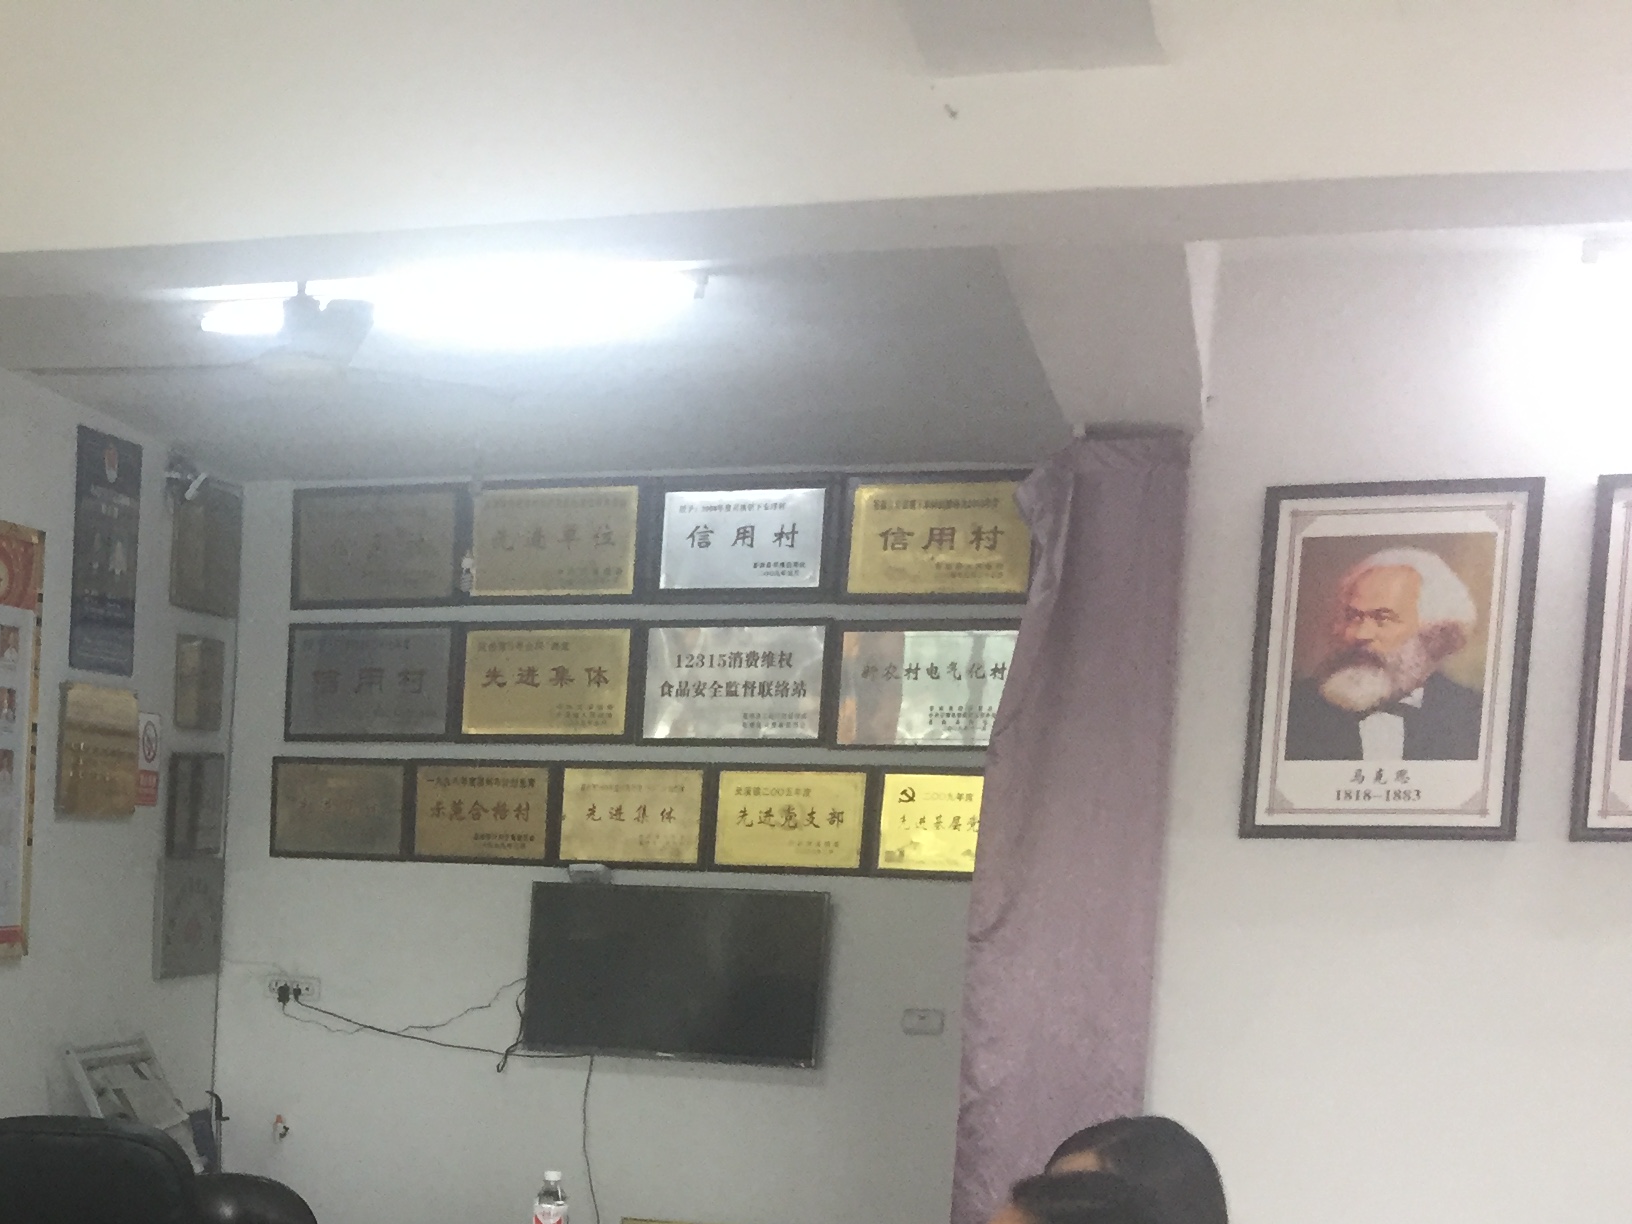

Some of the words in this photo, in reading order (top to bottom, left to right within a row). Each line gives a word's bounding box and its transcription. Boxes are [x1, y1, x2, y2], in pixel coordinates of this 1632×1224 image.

[686, 522, 799, 549] 信用村
[878, 525, 1005, 551] 信用村
[675, 650, 793, 669] 12315消费维权
[481, 665, 610, 688] 先进集体
[659, 680, 807, 699] 食品安全监督联络站
[1350, 767, 1411, 785] 马克思
[585, 803, 676, 824] 先进集体
[736, 804, 845, 829] 先进党支部
